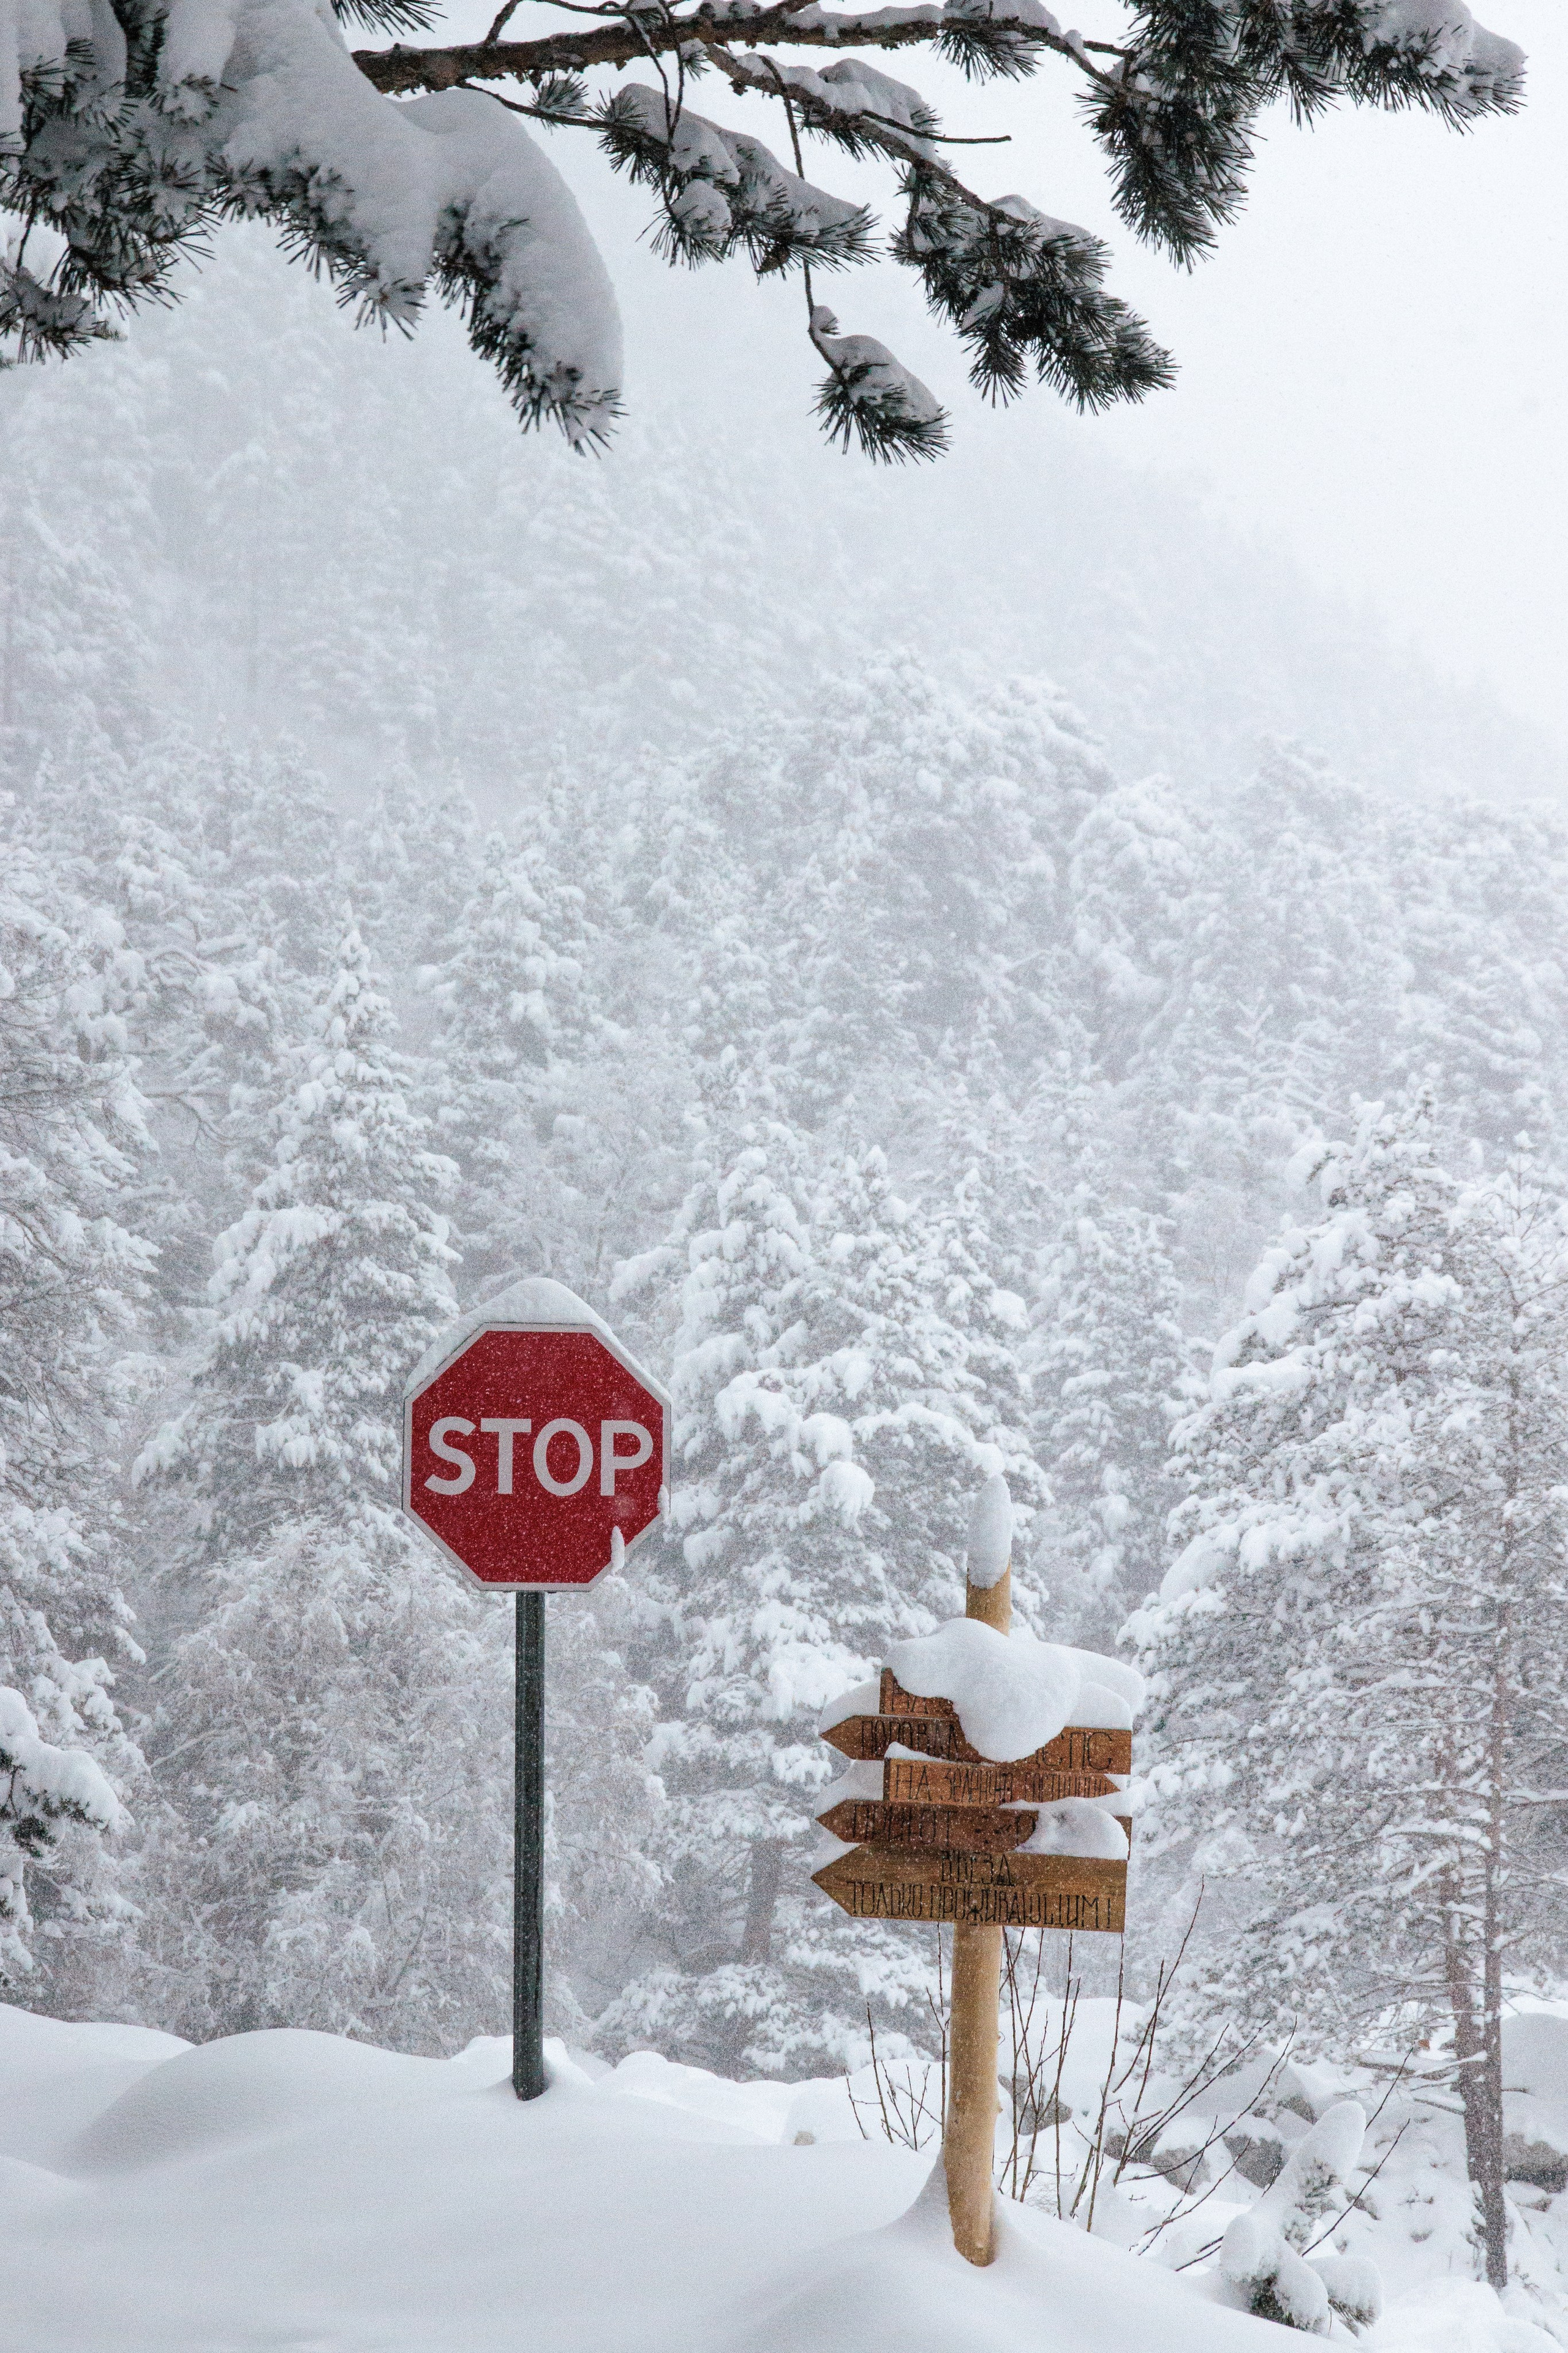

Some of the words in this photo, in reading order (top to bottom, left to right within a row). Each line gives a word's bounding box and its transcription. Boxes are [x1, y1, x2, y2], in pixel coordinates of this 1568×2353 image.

[424, 1416, 654, 1497] STOP
[895, 1764, 932, 1801] НА
[852, 1803, 957, 1847] ПРИЮТ
[843, 1880, 923, 1917] ТОЛЬКО
